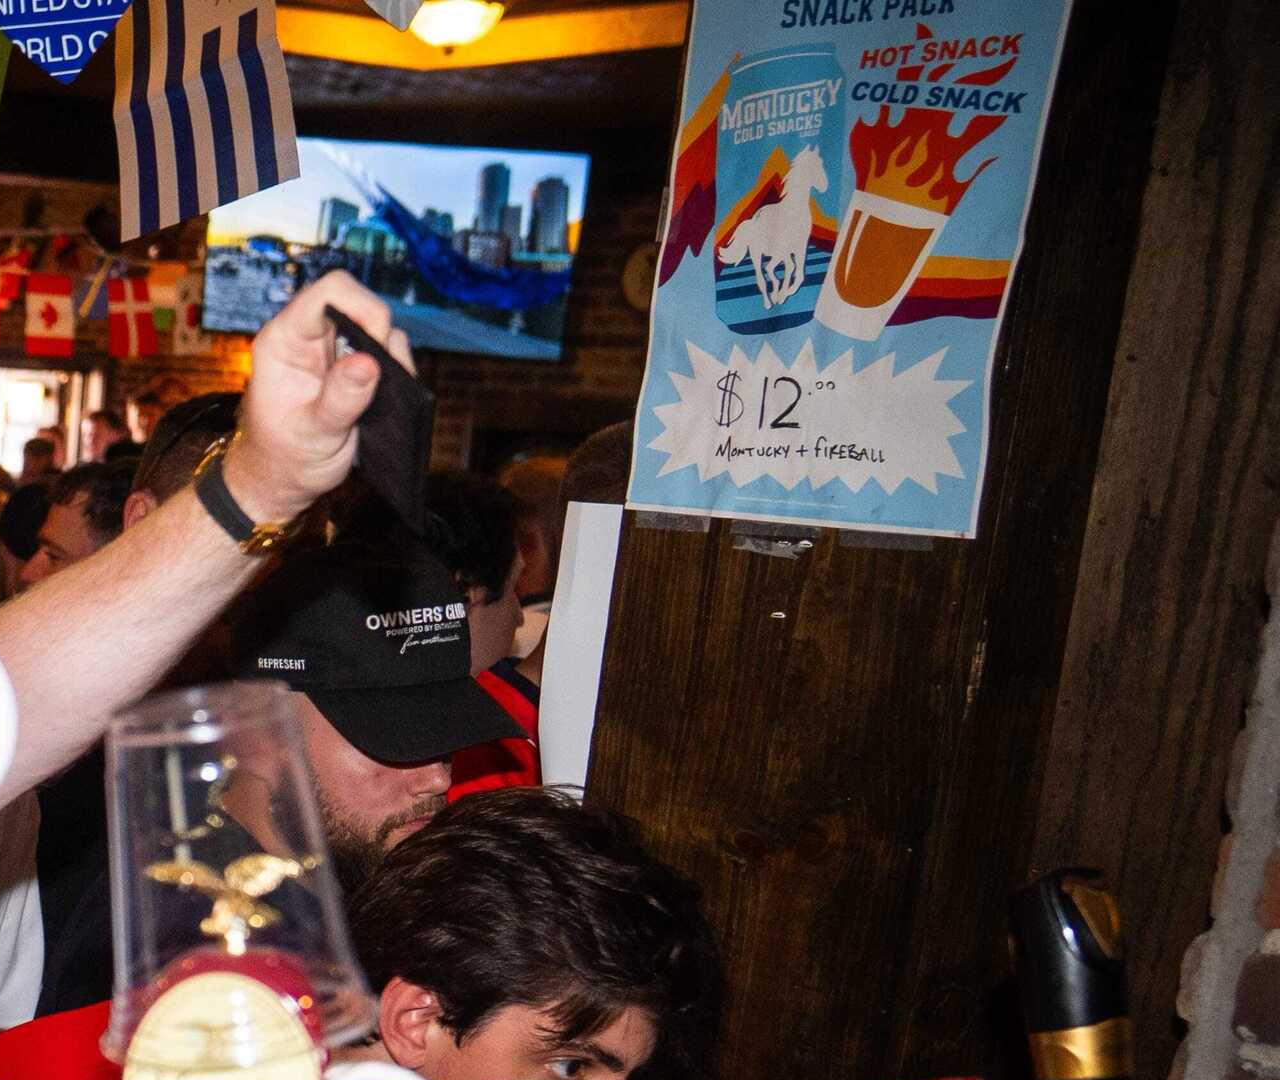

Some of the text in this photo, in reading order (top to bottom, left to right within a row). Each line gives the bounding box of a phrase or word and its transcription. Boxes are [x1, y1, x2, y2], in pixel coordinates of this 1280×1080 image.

[780, 0, 874, 28] SNACK
[859, 33, 1025, 69] HOT SNACK
[721, 78, 843, 130] MONTUCKY
[851, 81, 1029, 114] COLD SNACK
[733, 126, 763, 144] COLD
[767, 113, 823, 136] SNACKS
[257, 657, 306, 671] REPRESENT
